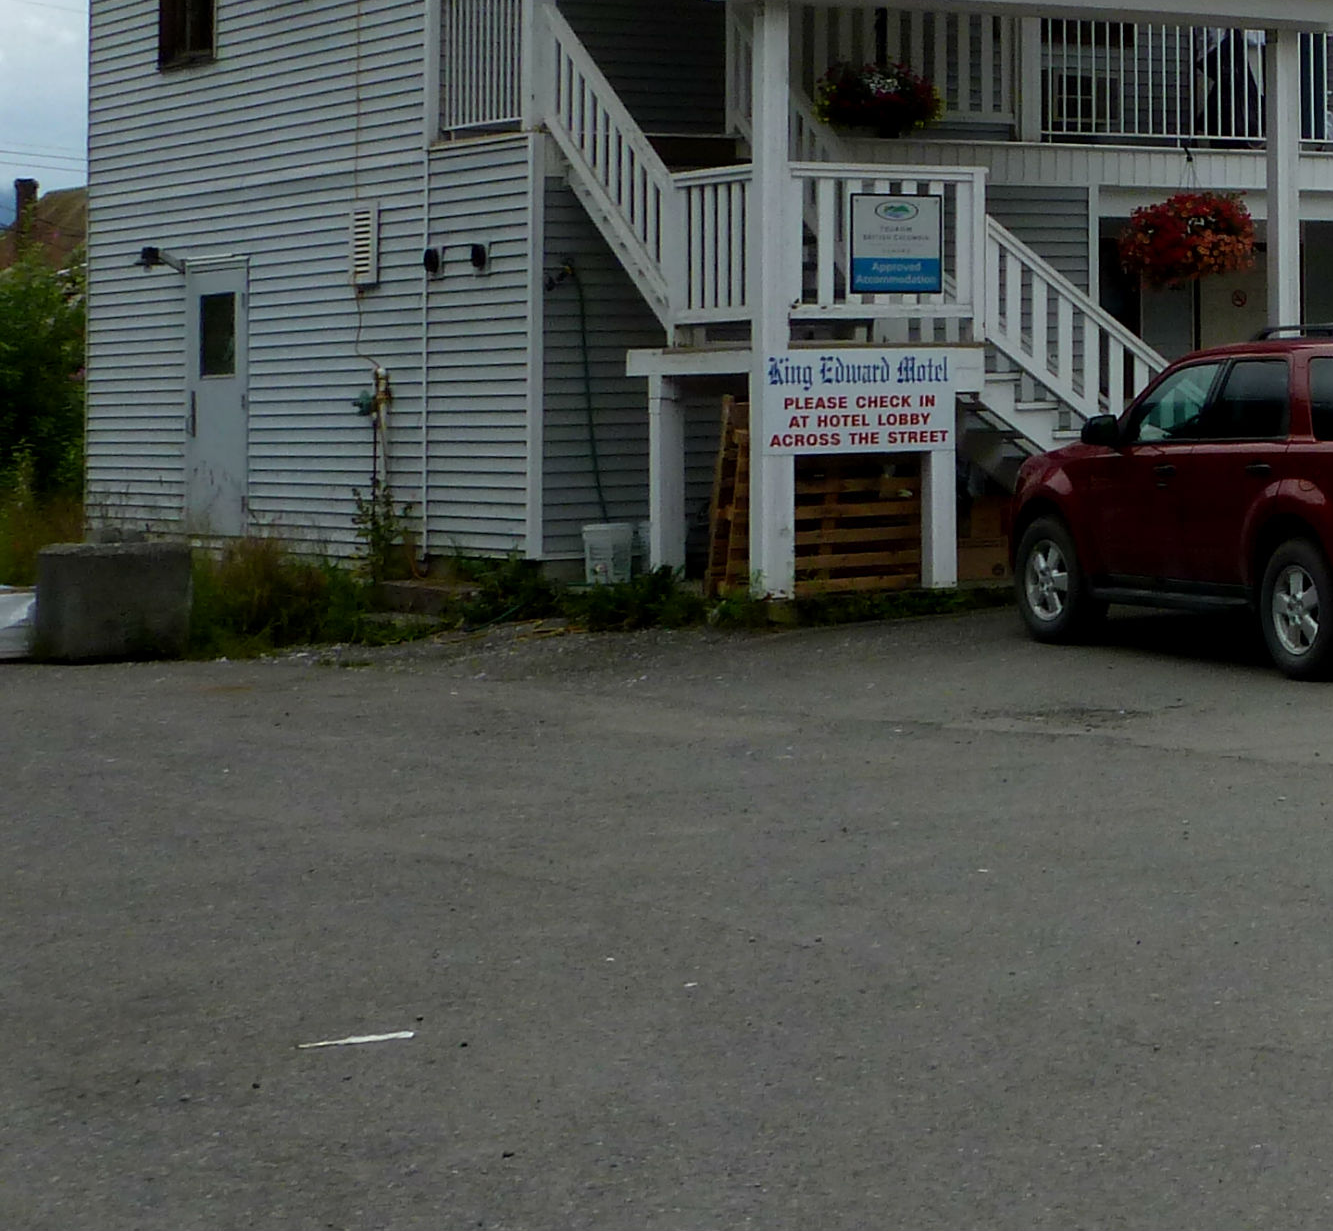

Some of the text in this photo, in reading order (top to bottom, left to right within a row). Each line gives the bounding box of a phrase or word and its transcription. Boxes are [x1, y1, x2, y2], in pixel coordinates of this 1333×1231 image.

[871, 261, 922, 274] Approved
[855, 274, 938, 285] Accommodation
[768, 356, 949, 391] King Edward Motel
[784, 394, 936, 410] PLEASE CHECK IN
[788, 413, 931, 429] AT HOTEL LOBBY
[769, 430, 949, 448] ACROSS THE STREET
